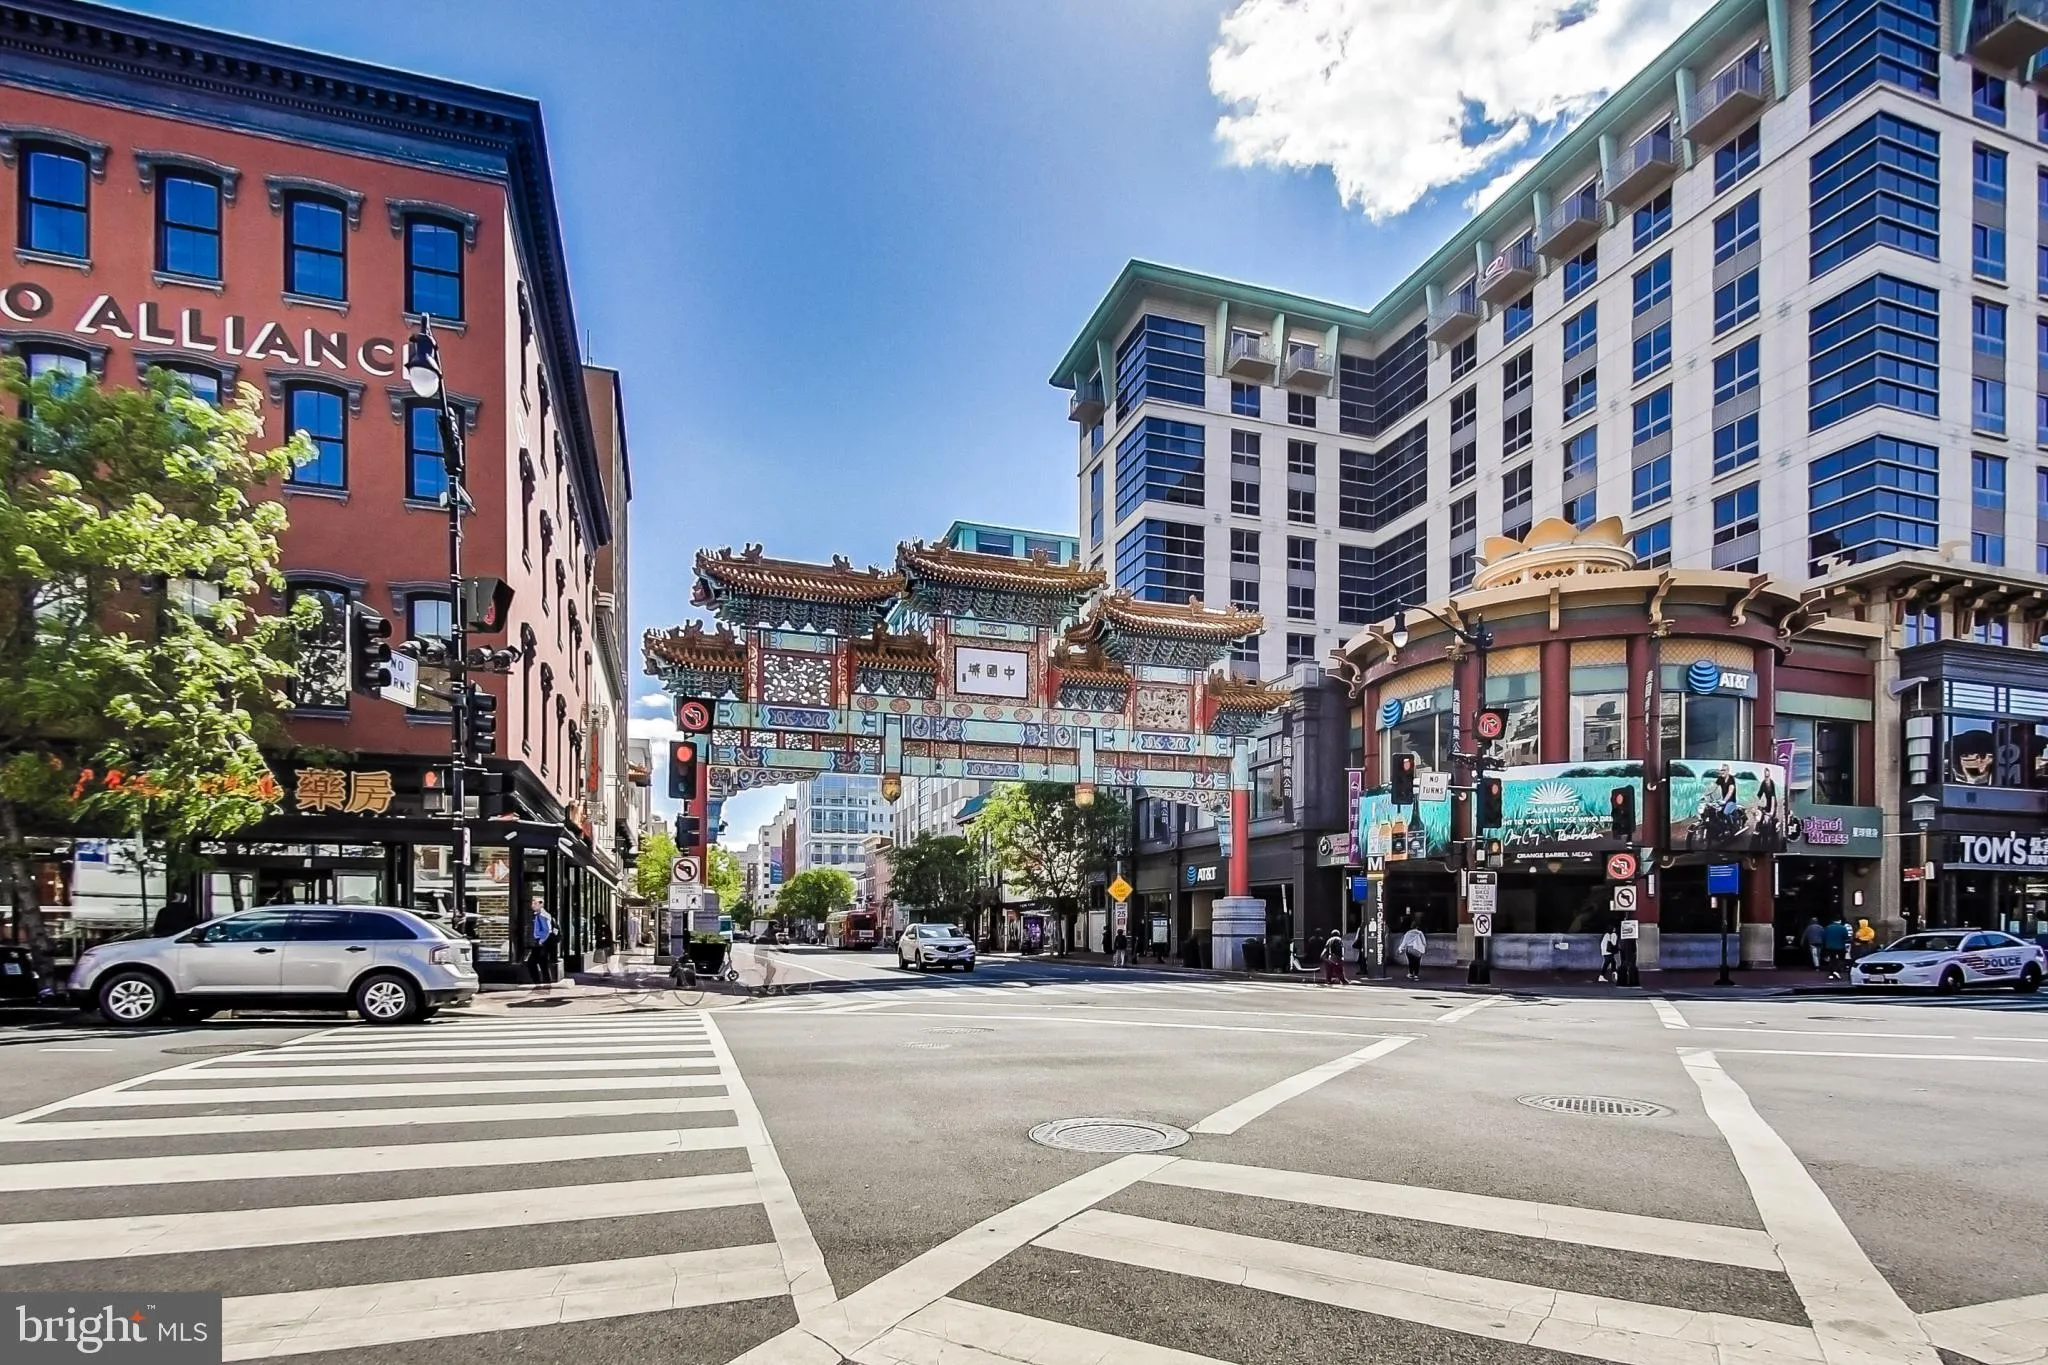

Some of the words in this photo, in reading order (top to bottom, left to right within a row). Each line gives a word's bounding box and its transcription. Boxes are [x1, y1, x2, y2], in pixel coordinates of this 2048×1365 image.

[390, 657, 405, 672] NO
[392, 677, 412, 694] RNS
[1718, 672, 1750, 690] AT&T
[1402, 694, 1435, 717] AT&T
[1429, 775, 1440, 784] NO
[293, 767, 397, 814] 藥房
[1421, 785, 1444, 795] TURNS
[1553, 816, 1577, 824] THOSE
[1578, 815, 1599, 823] WHO
[1803, 816, 1844, 832] planet
[1807, 830, 1850, 845] fitness
[1959, 831, 2027, 865] TOM'S
[1367, 856, 1383, 872] M
[1197, 866, 1217, 882] AT&T
[1116, 910, 1126, 918] 25
[1984, 956, 2022, 968] POLICE
